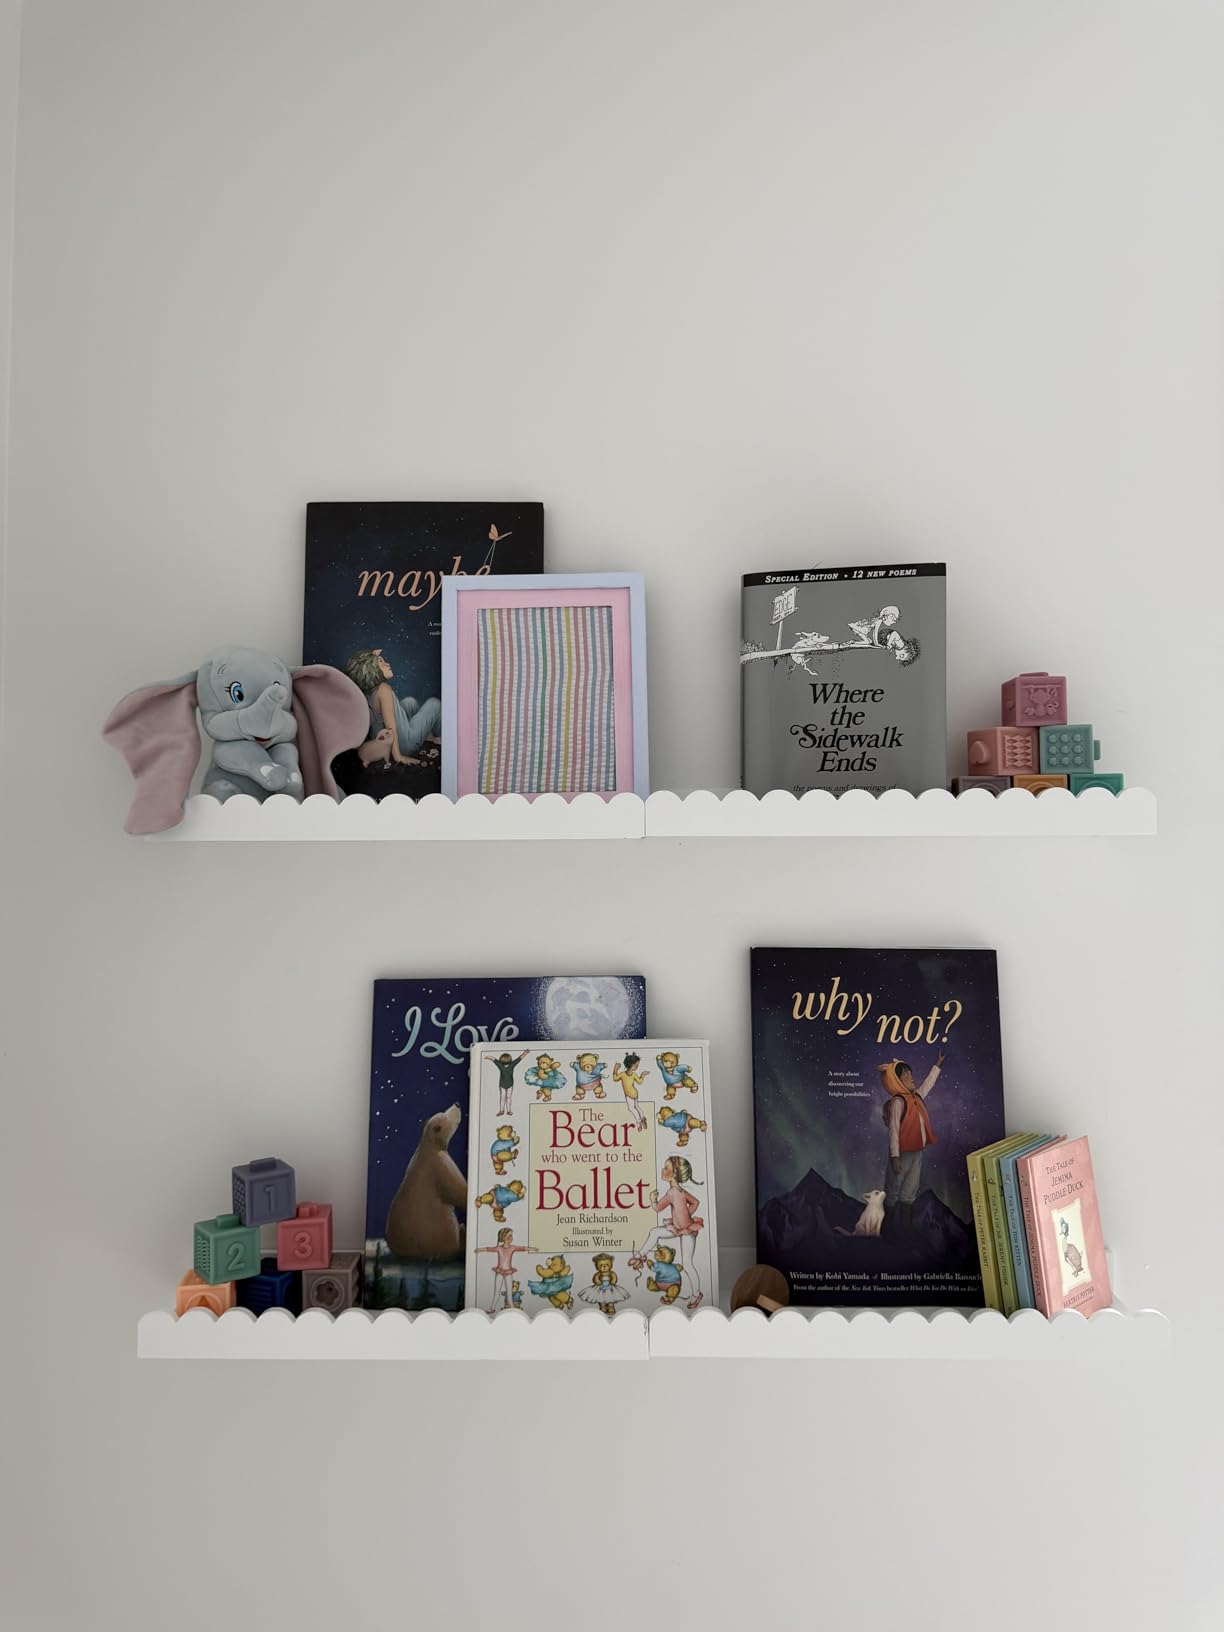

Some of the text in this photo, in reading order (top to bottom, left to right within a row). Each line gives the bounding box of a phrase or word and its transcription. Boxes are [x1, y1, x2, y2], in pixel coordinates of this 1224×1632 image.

[852, 570, 864, 579] 12
[809, 682, 885, 705] Where
[830, 705, 866, 728] the
[789, 724, 904, 752] Sidewalk
[816, 751, 877, 773] Ends
[793, 784, 805, 792] the
[834, 784, 849, 792] and
[791, 976, 873, 1036] why
[392, 1002, 519, 1064] I Love
[876, 999, 963, 1044] not?
[579, 1108, 604, 1121] The
[549, 1110, 635, 1148] Bear
[541, 1148, 643, 1163] who went to the
[264, 1185, 275, 1213] 1
[535, 1166, 651, 1210] Ballet
[556, 1213, 629, 1226] Jean Richardson
[562, 1236, 623, 1247] Susan Winter
[572, 1227, 613, 1236] Illustrated by
[294, 1231, 312, 1258] 3
[226, 1243, 246, 1271] 2
[789, 1271, 815, 1280] Written
[815, 1271, 824, 1281] by
[825, 1271, 842, 1280] Kobi
[842, 1272, 870, 1281] Yamada
[880, 1272, 913, 1281] Illustrated
[913, 1272, 922, 1281] by
[923, 1272, 954, 1281] Gabriella
